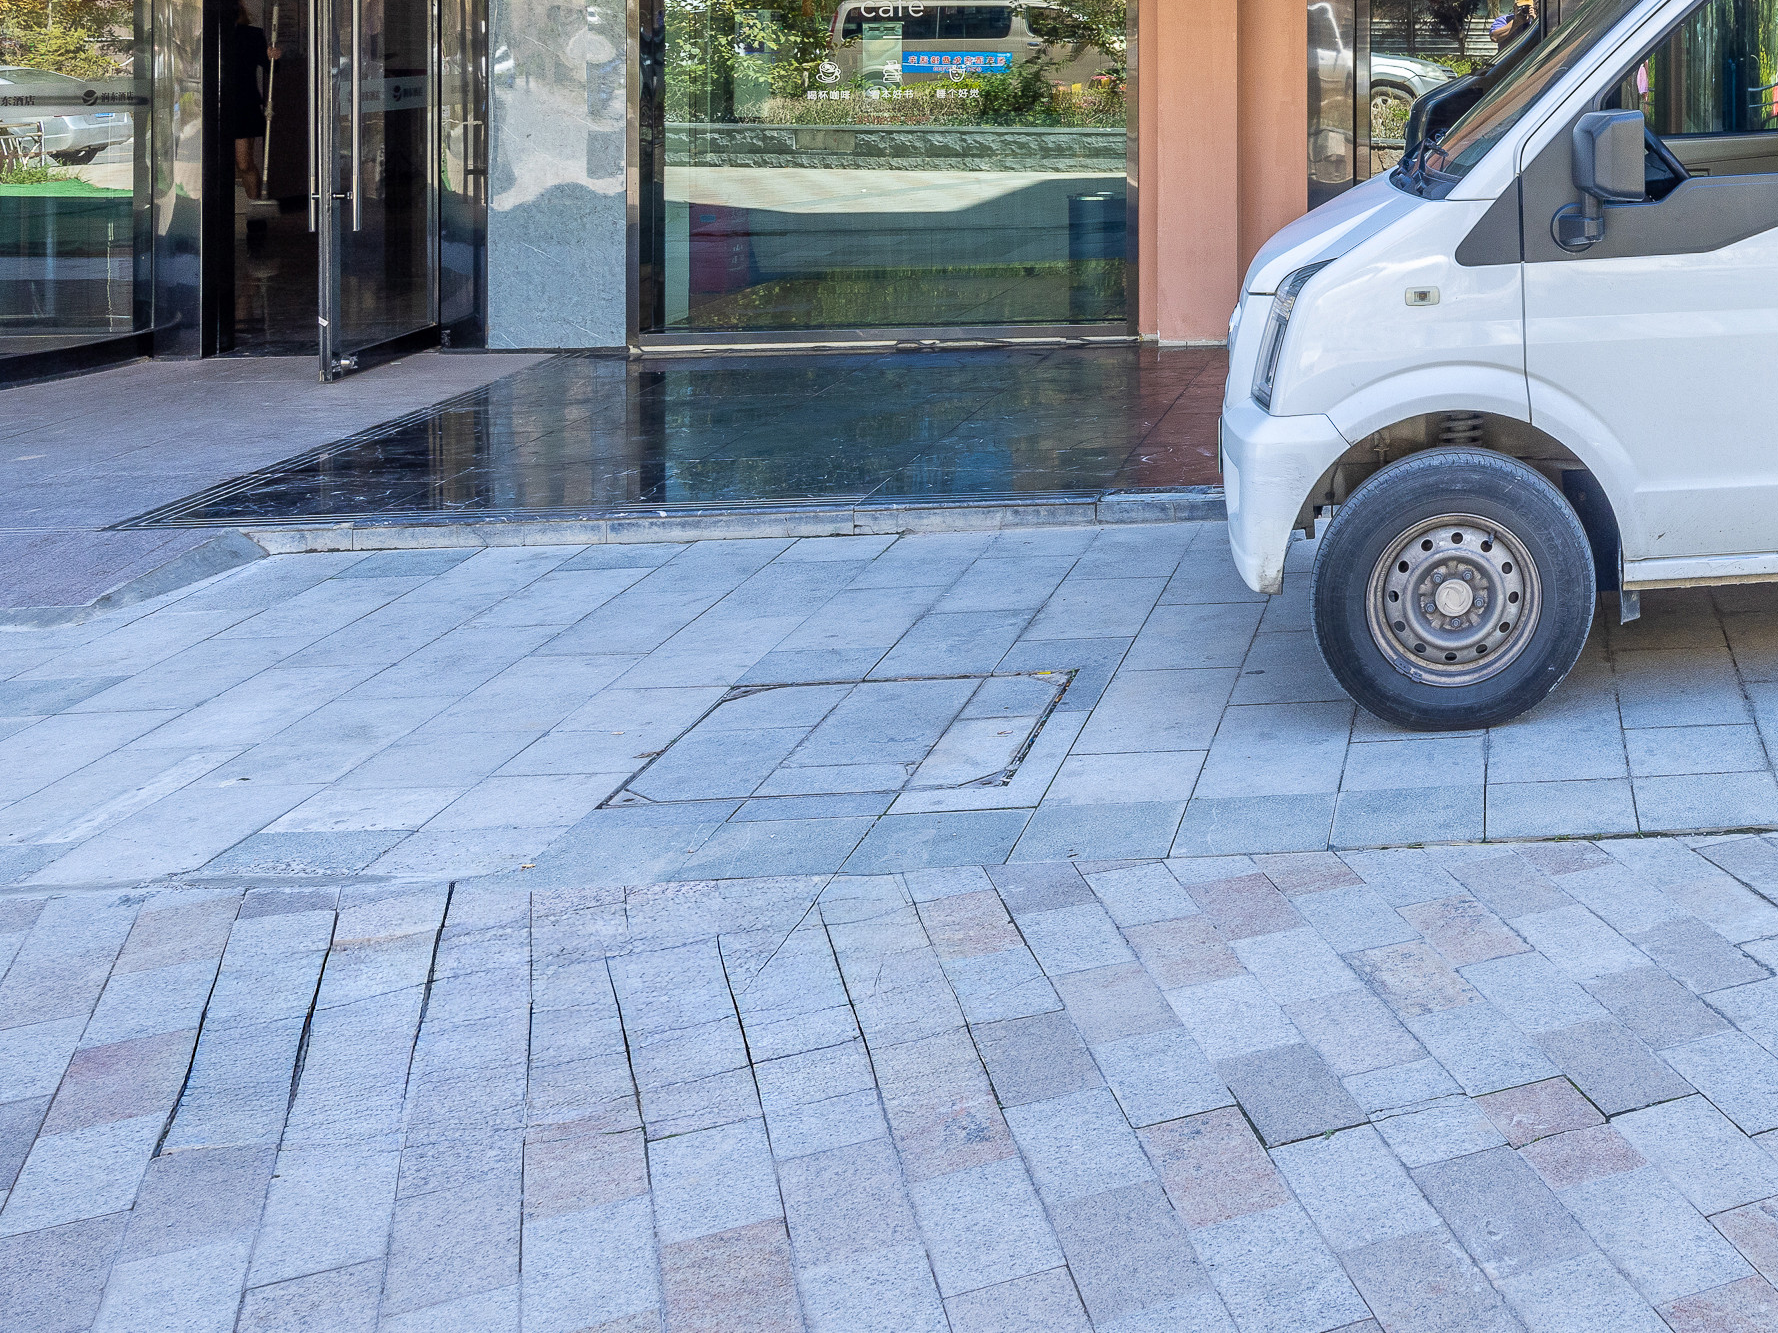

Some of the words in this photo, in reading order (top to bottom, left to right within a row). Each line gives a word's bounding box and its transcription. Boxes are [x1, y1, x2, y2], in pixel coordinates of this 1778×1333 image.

[807, 90, 851, 100] 喝杯咖啡
[869, 89, 914, 100] 看本好书
[936, 88, 980, 99] 睡个好觉
